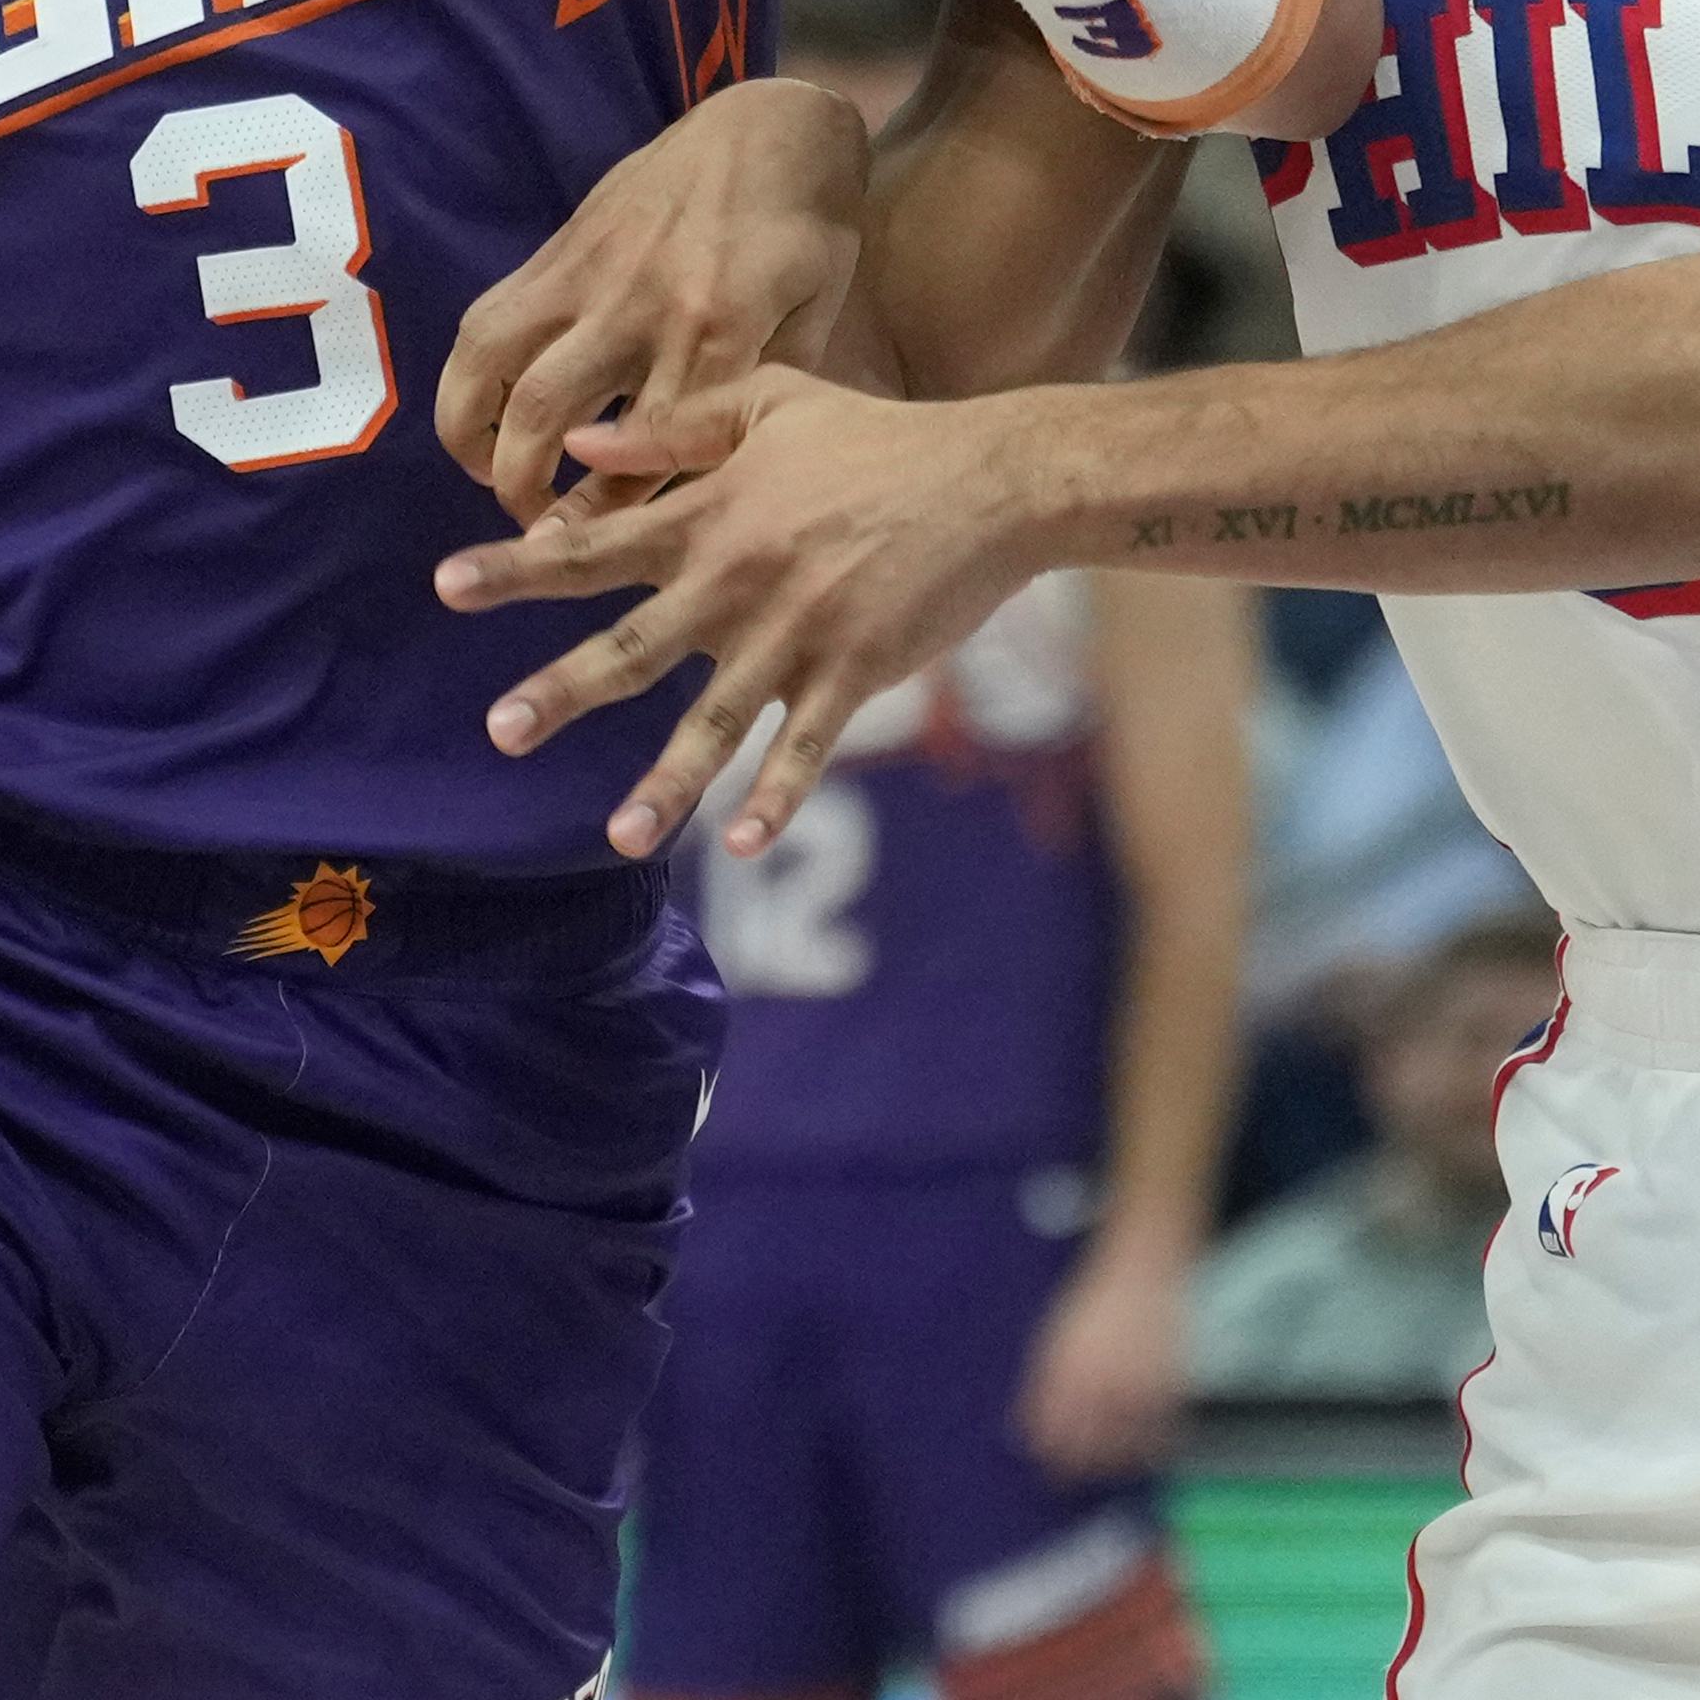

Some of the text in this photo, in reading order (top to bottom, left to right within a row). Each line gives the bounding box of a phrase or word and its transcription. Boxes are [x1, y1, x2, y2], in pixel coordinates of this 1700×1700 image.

[130, 93, 399, 472] 3
[1131, 480, 1572, 551] XI XVI MCMLXVI
